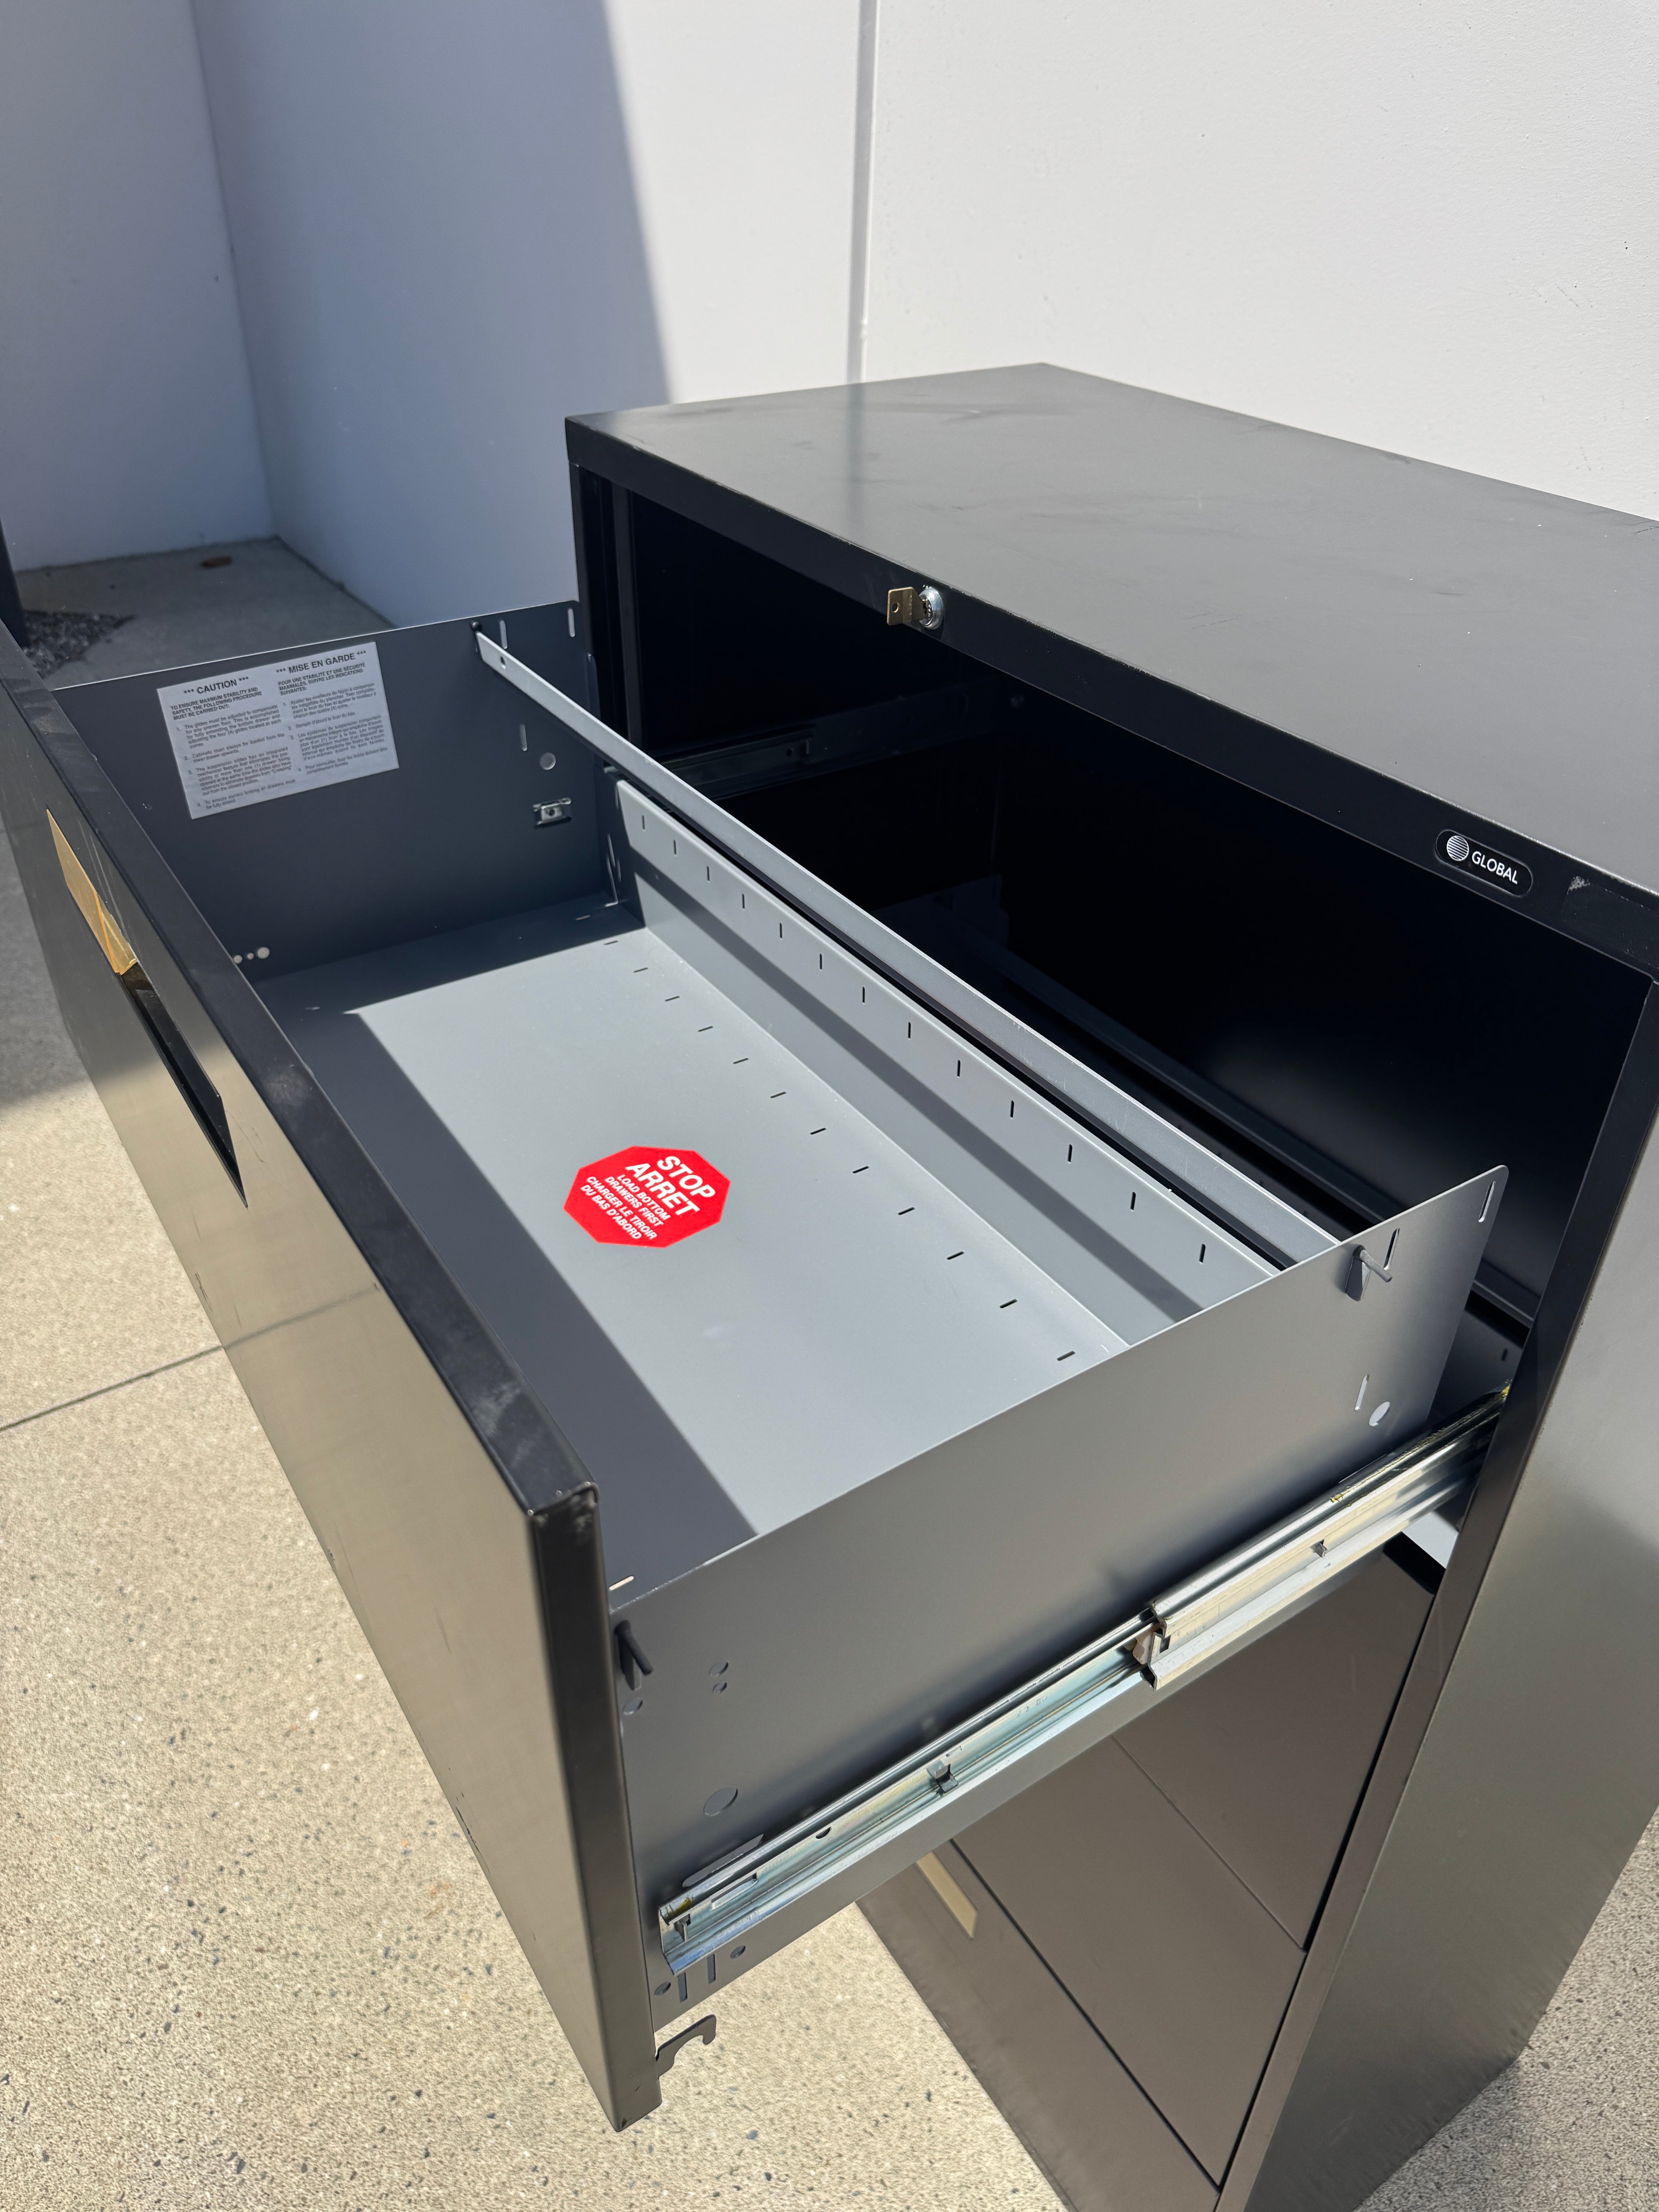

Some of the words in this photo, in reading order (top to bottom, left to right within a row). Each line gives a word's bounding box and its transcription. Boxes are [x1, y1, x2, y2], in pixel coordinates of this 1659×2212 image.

[289, 663, 310, 673] MISE
[311, 660, 324, 668] EN
[326, 653, 355, 665] GARDE
[197, 680, 237, 694] CAUTION
[200, 695, 223, 704] MAXIMUM
[223, 690, 247, 699] STABILITY
[204, 699, 232, 708] FOLLOWING
[233, 692, 262, 701] PROCEDURE
[196, 707, 218, 715] CARRIED
[1471, 851, 1518, 884] GLOBAL
[625, 1163, 700, 1215] ARRET
[657, 1156, 715, 1197] STOP
[581, 1184, 596, 1196] DU
[592, 1194, 610, 1210] BAS
[607, 1208, 642, 1239] D'ABORD
[587, 1176, 623, 1208] CHARGER
[619, 1204, 633, 1217] LE
[630, 1215, 658, 1239] TIROIR
[604, 1176, 642, 1208] DRAWERS
[639, 1205, 664, 1227] FIRST
[617, 1174, 640, 1194] LOAD
[637, 1192, 671, 1220] BOTTOM
